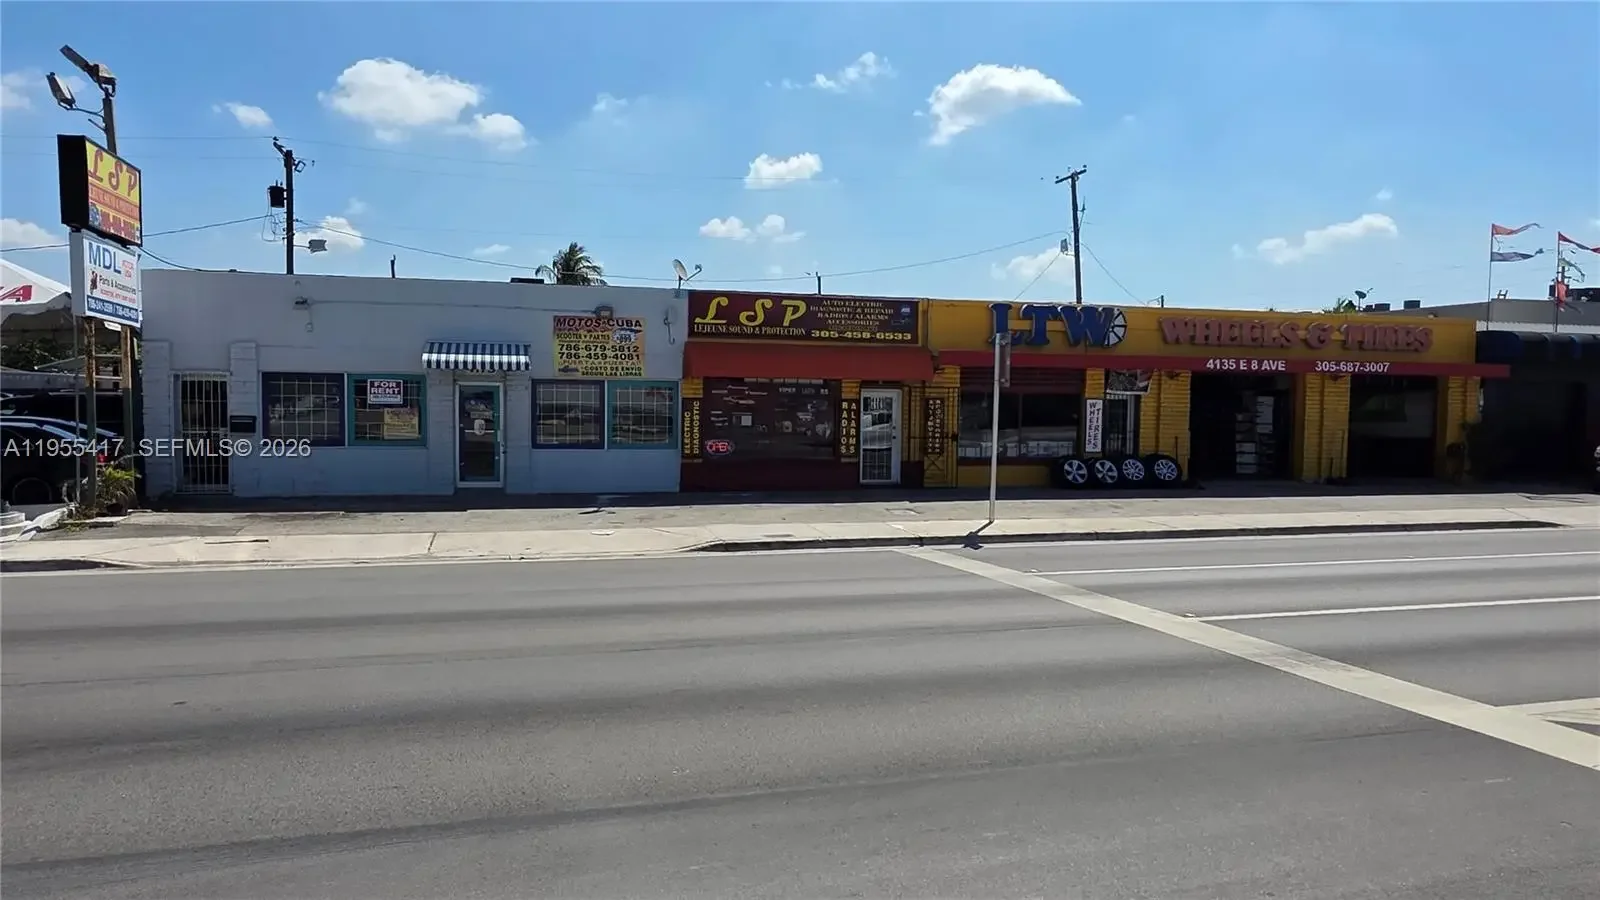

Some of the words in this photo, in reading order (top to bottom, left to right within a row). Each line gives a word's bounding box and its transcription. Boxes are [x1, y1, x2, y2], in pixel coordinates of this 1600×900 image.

[89, 241, 122, 275] MDL
[694, 324, 727, 334] LEJEUNE
[729, 325, 753, 334] SOUND
[755, 326, 761, 334] &
[762, 326, 806, 336] PROTECTION
[988, 303, 1115, 347] LTW
[1160, 316, 1301, 348] WHEELS
[1305, 321, 1334, 350] &
[1340, 324, 1434, 352] TIRES
[558, 344, 640, 353] 786-679-5812
[558, 352, 640, 361] 786-459-4081
[1206, 359, 1237, 370] 4135
[1239, 359, 1248, 370] E
[1250, 359, 1259, 370] 8
[1260, 360, 1287, 371] AVE
[1315, 361, 1391, 373] 305-687-3007
[684, 411, 692, 454] ELECTRIC
[693, 400, 701, 454] DIAGNOSTIC
[841, 402, 849, 454] RADIOS
[1087, 402, 1097, 446] WHEELS
[1092, 408, 1101, 449] TIRES
